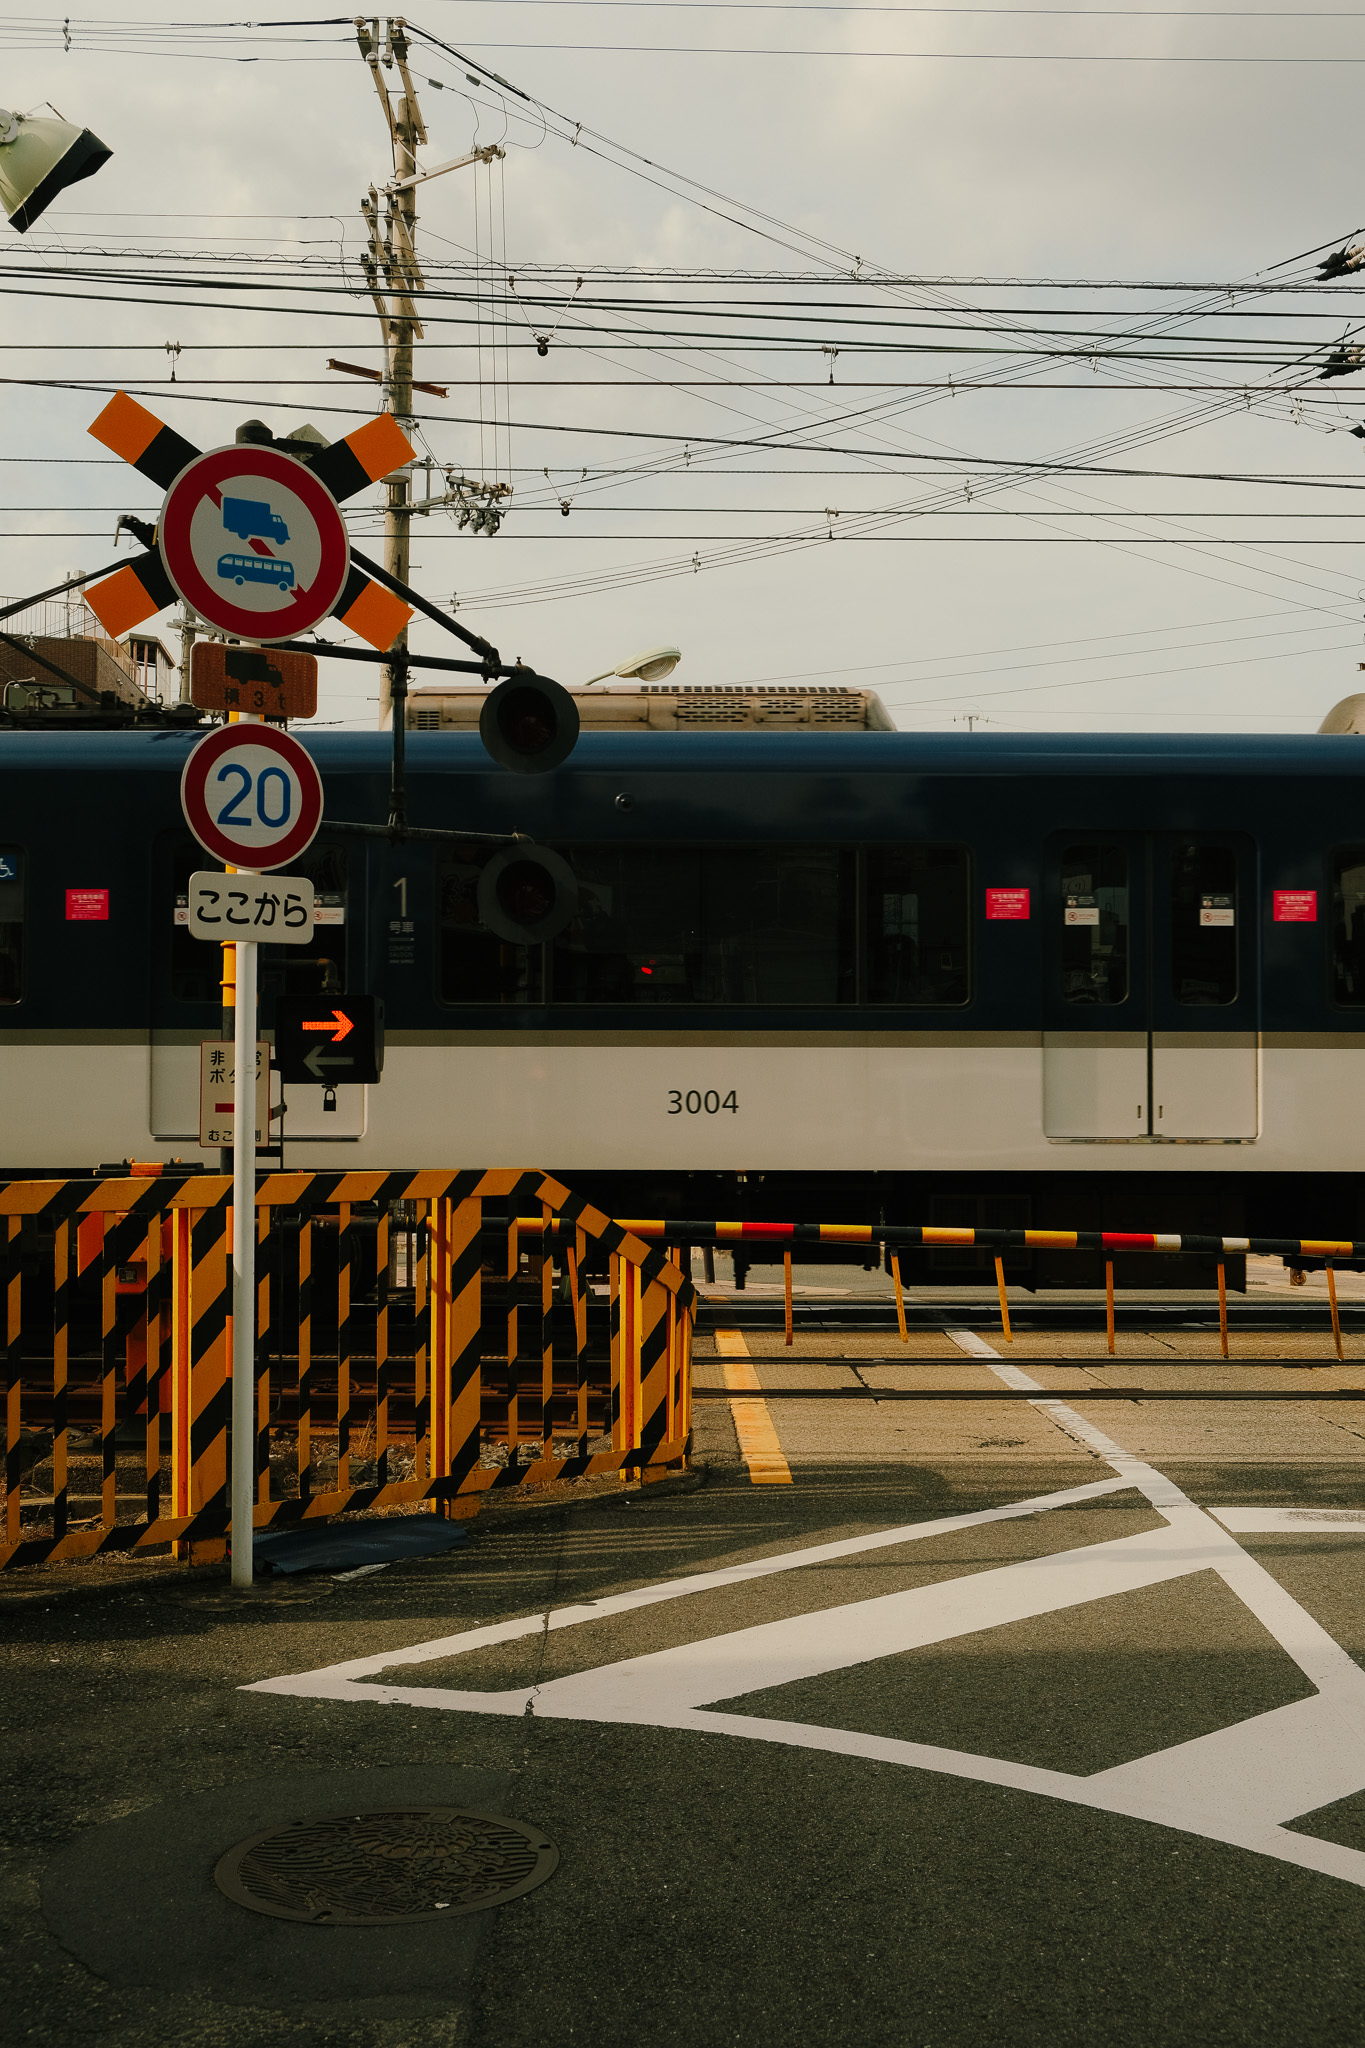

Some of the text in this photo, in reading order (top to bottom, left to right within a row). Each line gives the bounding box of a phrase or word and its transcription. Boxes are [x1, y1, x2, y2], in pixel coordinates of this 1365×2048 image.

[217, 763, 291, 828] 20
[197, 890, 307, 927] ここから
[392, 877, 407, 917] 1
[667, 1090, 739, 1114] 3004
